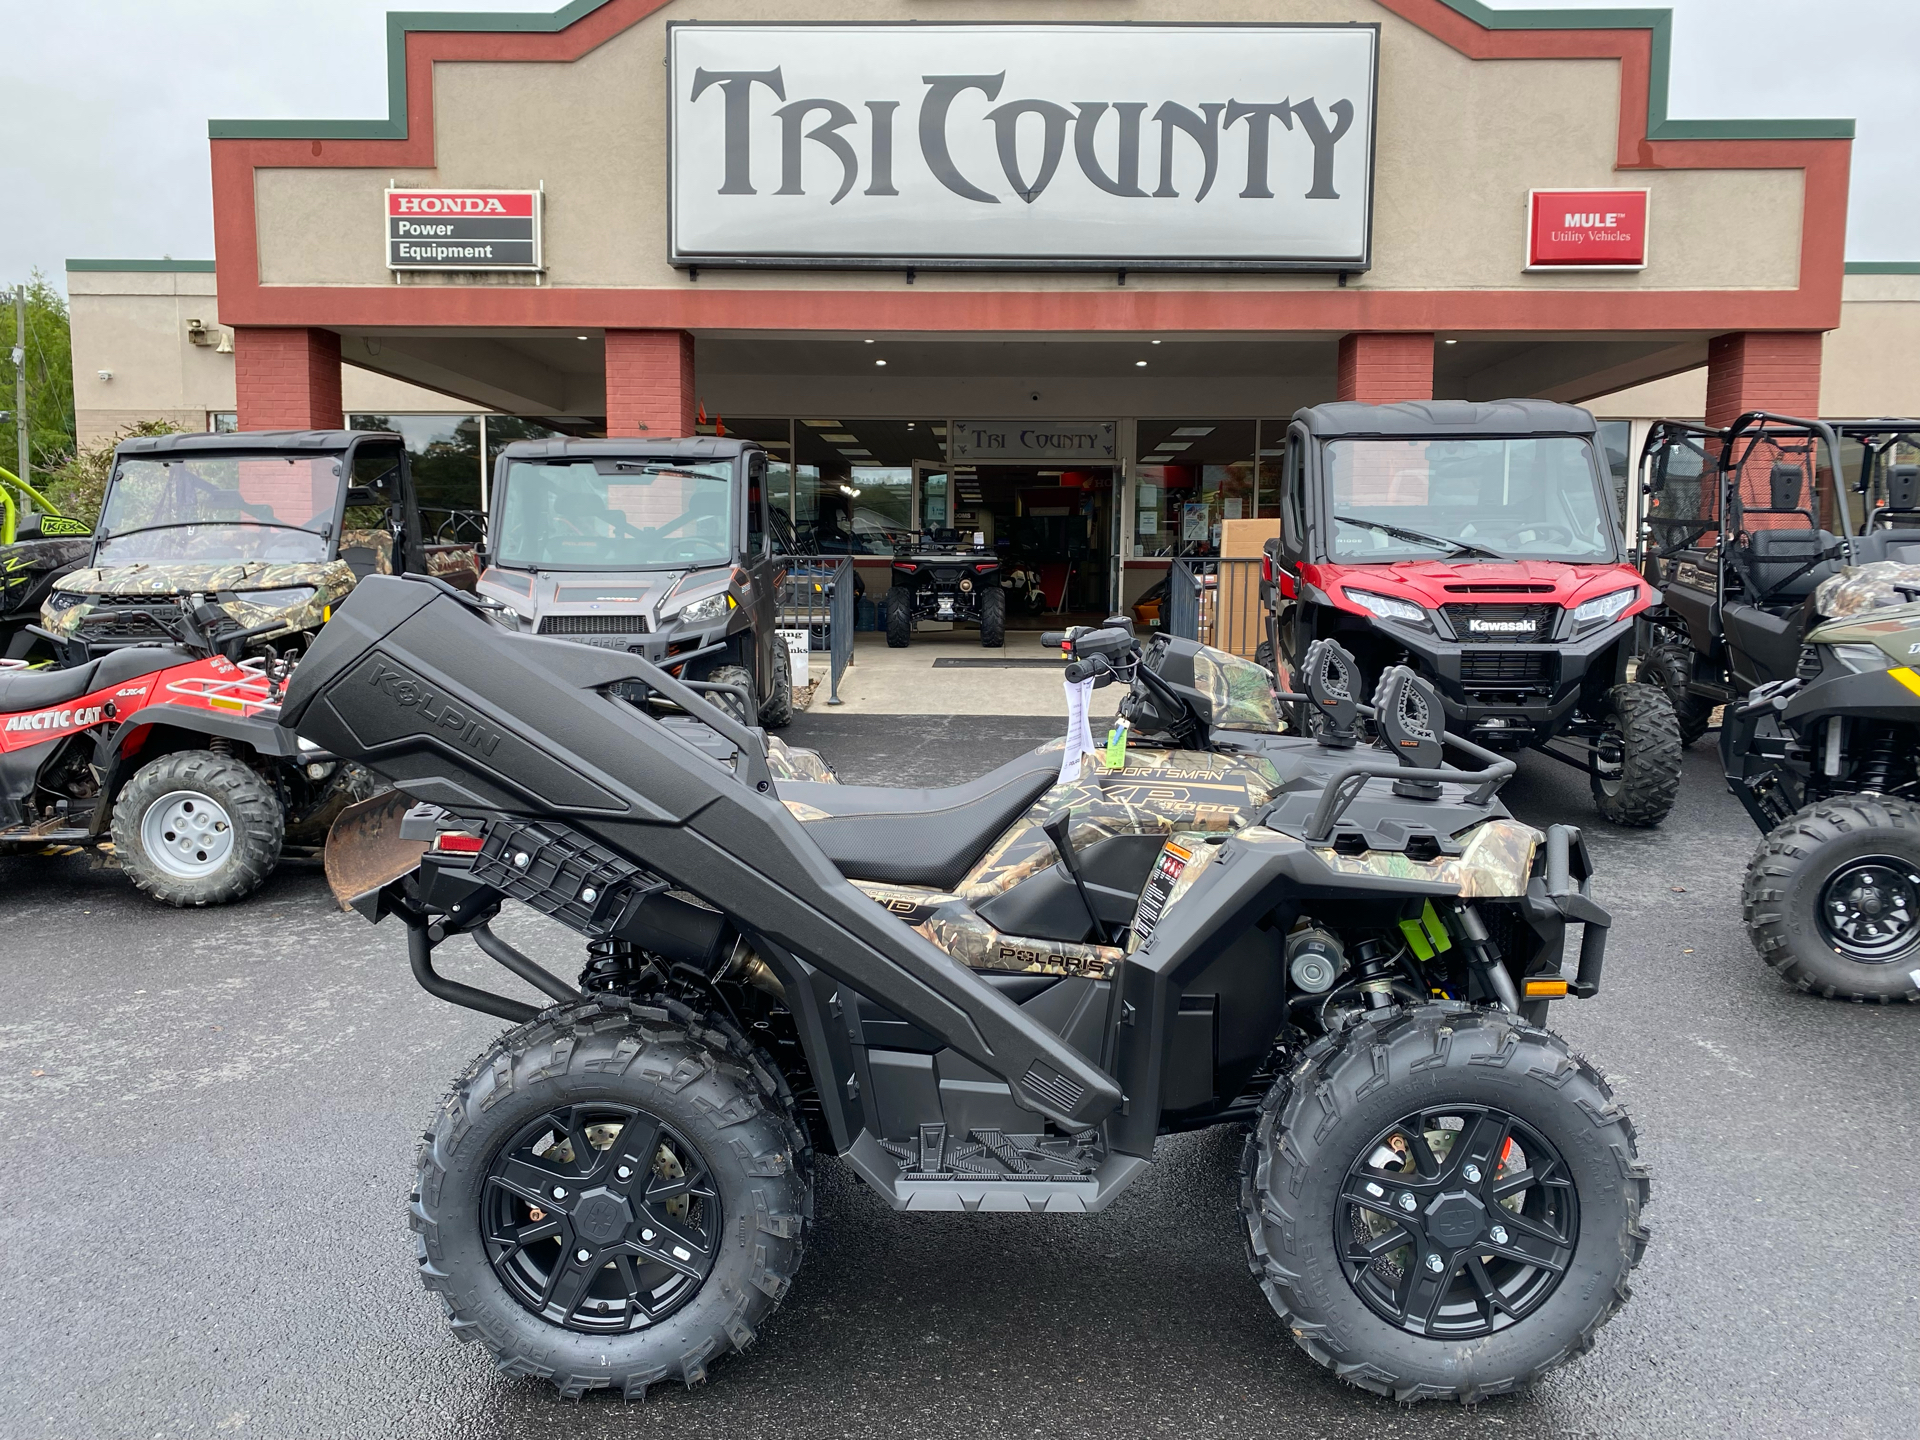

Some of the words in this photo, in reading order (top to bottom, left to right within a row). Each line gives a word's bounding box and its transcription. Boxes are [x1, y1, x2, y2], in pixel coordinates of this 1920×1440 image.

[397, 198, 506, 212] HONDA
[398, 221, 454, 235] Power
[1551, 231, 1585, 244] Utility
[1588, 231, 1631, 241] Vehicles
[398, 243, 493, 260] Equipment
[1469, 620, 1536, 631] Kawasaki
[5, 710, 70, 731] ARCTIC
[74, 706, 102, 726] CAT
[367, 663, 501, 757] KOLPIN
[1094, 767, 1225, 781] SPORTSMAN
[1056, 785, 1190, 809] XP
[1165, 801, 1240, 814] 1000
[999, 946, 1105, 973] POLARIS
[1302, 1242, 1355, 1337] POLARIS
[465, 1289, 549, 1364] POLARIS
